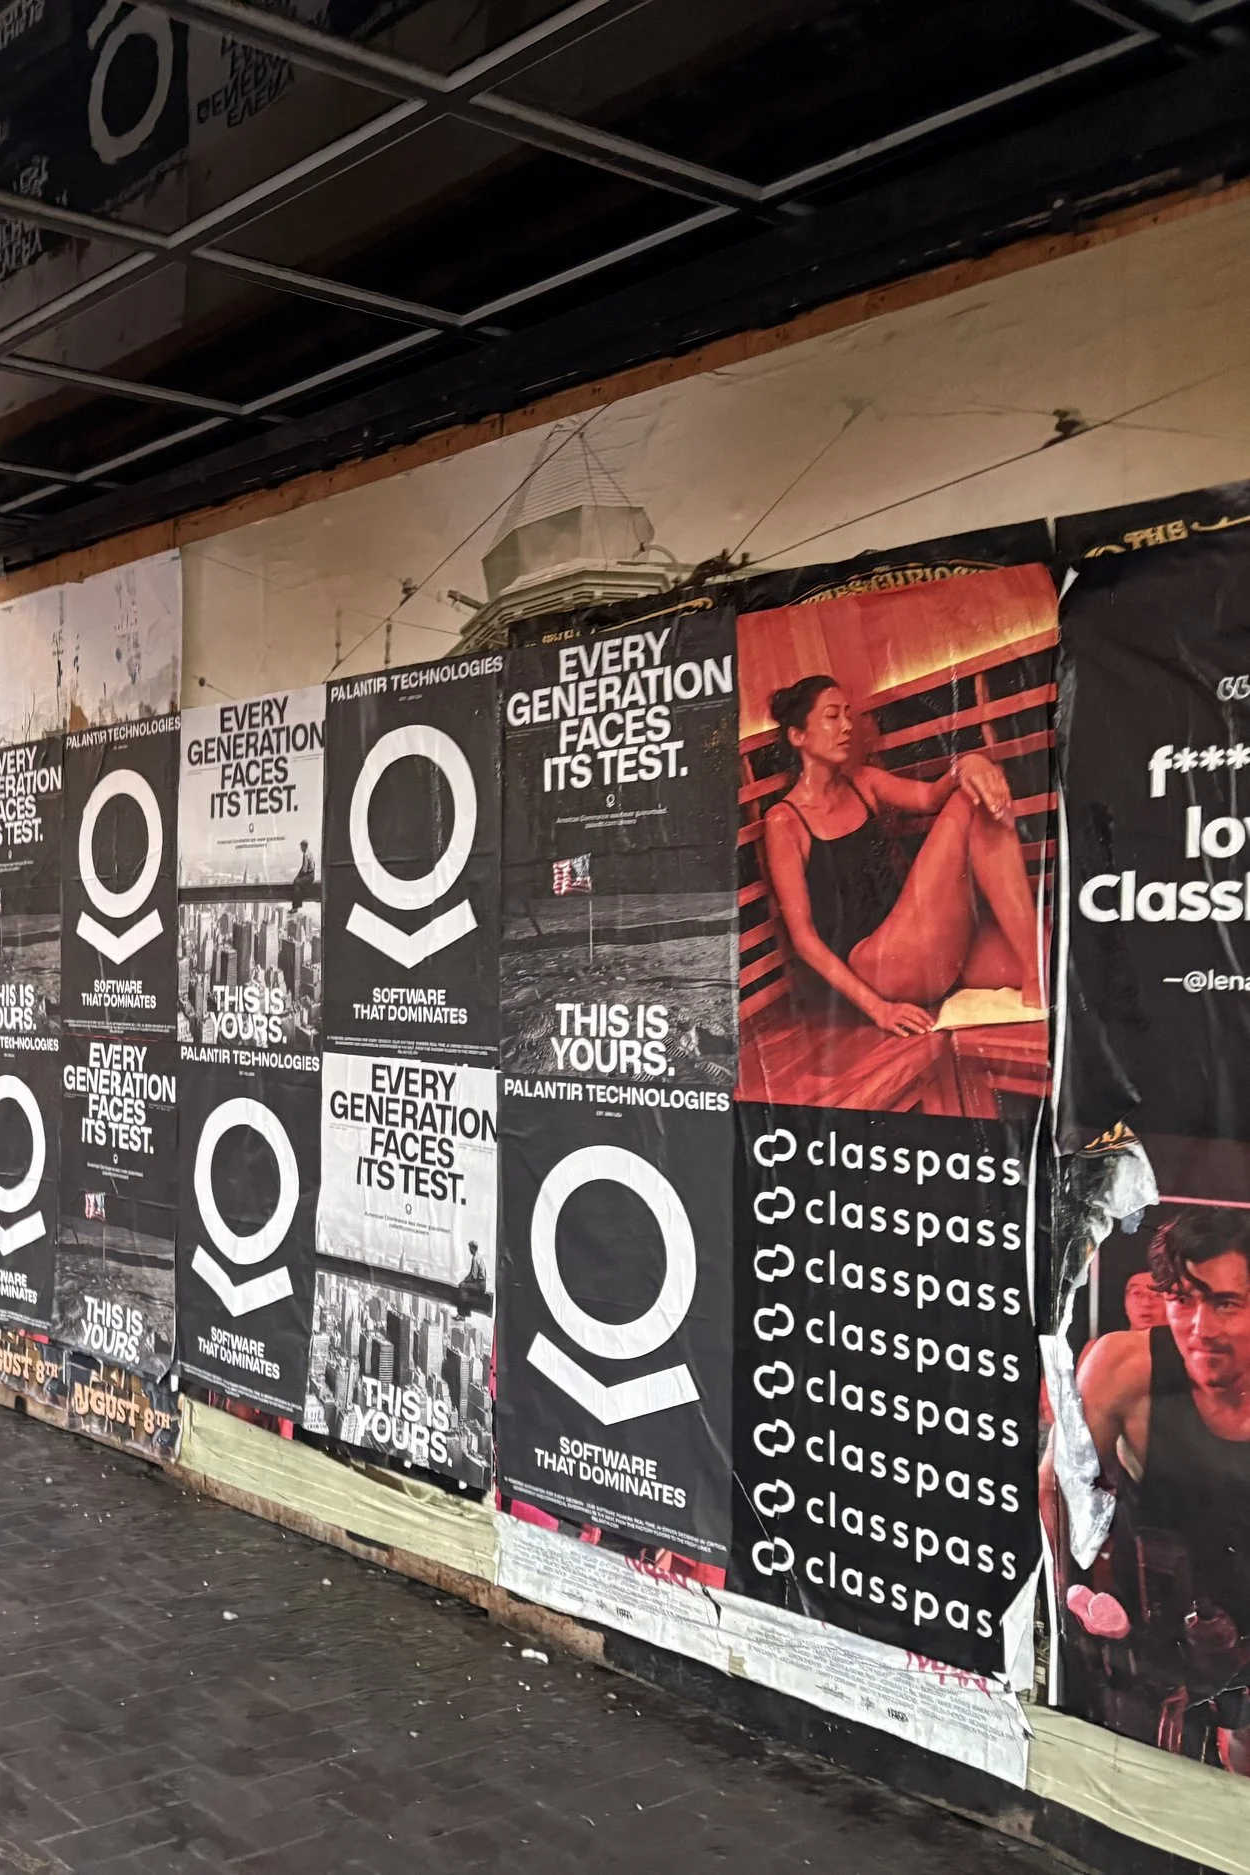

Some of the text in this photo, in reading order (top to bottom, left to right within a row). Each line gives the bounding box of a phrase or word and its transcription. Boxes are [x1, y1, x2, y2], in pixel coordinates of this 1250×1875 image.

[1123, 519, 1189, 551] THE
[559, 628, 672, 684] EVERY
[331, 656, 503, 702] PALANTIR TECHNOLOGIES
[506, 655, 734, 727] GENERATION
[66, 715, 181, 749] PALANTIR TECHNOLOGIES
[220, 696, 289, 734] EVERY
[559, 705, 672, 756] FACES
[187, 720, 325, 766] GENERATION
[220, 757, 288, 789] FACES
[543, 740, 688, 792] ITS TEST.
[210, 784, 298, 819] ITS TEST.
[3, 817, 43, 845] TEST.
[1185, 806, 1250, 859] lo
[1078, 869, 1250, 922] Class
[19, 984, 35, 1005] IS
[81, 993, 156, 1010] THAT DOMINATES
[94, 979, 142, 995] SOFTWARE
[213, 985, 285, 1015] THIS IS
[373, 988, 446, 1006] SOFTWARE
[210, 1010, 287, 1044] YOURS.
[353, 1004, 468, 1025] THAT DOMINATES
[555, 1002, 669, 1040] THIS IS
[0, 1036, 59, 1052] TECHNOLOGIES
[89, 1042, 147, 1072] EVERY
[180, 1048, 320, 1072] PALANTIR TECHNOLOGIES
[550, 1037, 675, 1077] YOURS.
[63, 1065, 176, 1104] GENERATION
[371, 1063, 456, 1102] EVERY
[504, 1078, 730, 1112] PALANTIR TECHNOLOGIES
[88, 1094, 146, 1126] FACES
[330, 1090, 498, 1143] GENERATION
[81, 1117, 154, 1154] ITS TEST.
[370, 1127, 454, 1169] FACES
[806, 1131, 1021, 1186] classpass
[356, 1156, 467, 1206] ITS TEST.
[804, 1189, 1021, 1252] classpass
[804, 1250, 1020, 1316] classpass
[84, 1295, 123, 1330] THIS
[124, 1308, 143, 1336] IS
[81, 1318, 140, 1364] YOURS.
[197, 1336, 280, 1380] THAT DOMINATES
[210, 1325, 265, 1357] SOFTWARE
[804, 1309, 1020, 1384] classpass
[35, 1359, 59, 1385] 8TH
[144, 1409, 171, 1434] 8TH
[362, 1375, 451, 1431] THIS IS
[805, 1369, 1020, 1447] classpass
[355, 1406, 452, 1468] YOURS.
[533, 1447, 574, 1478] THAT
[579, 1461, 686, 1509] DOMINATES
[559, 1435, 658, 1481] SOFTWARE
[805, 1428, 1020, 1514] classpass
[805, 1489, 1017, 1582] classpass
[805, 1550, 994, 1639] classpas
